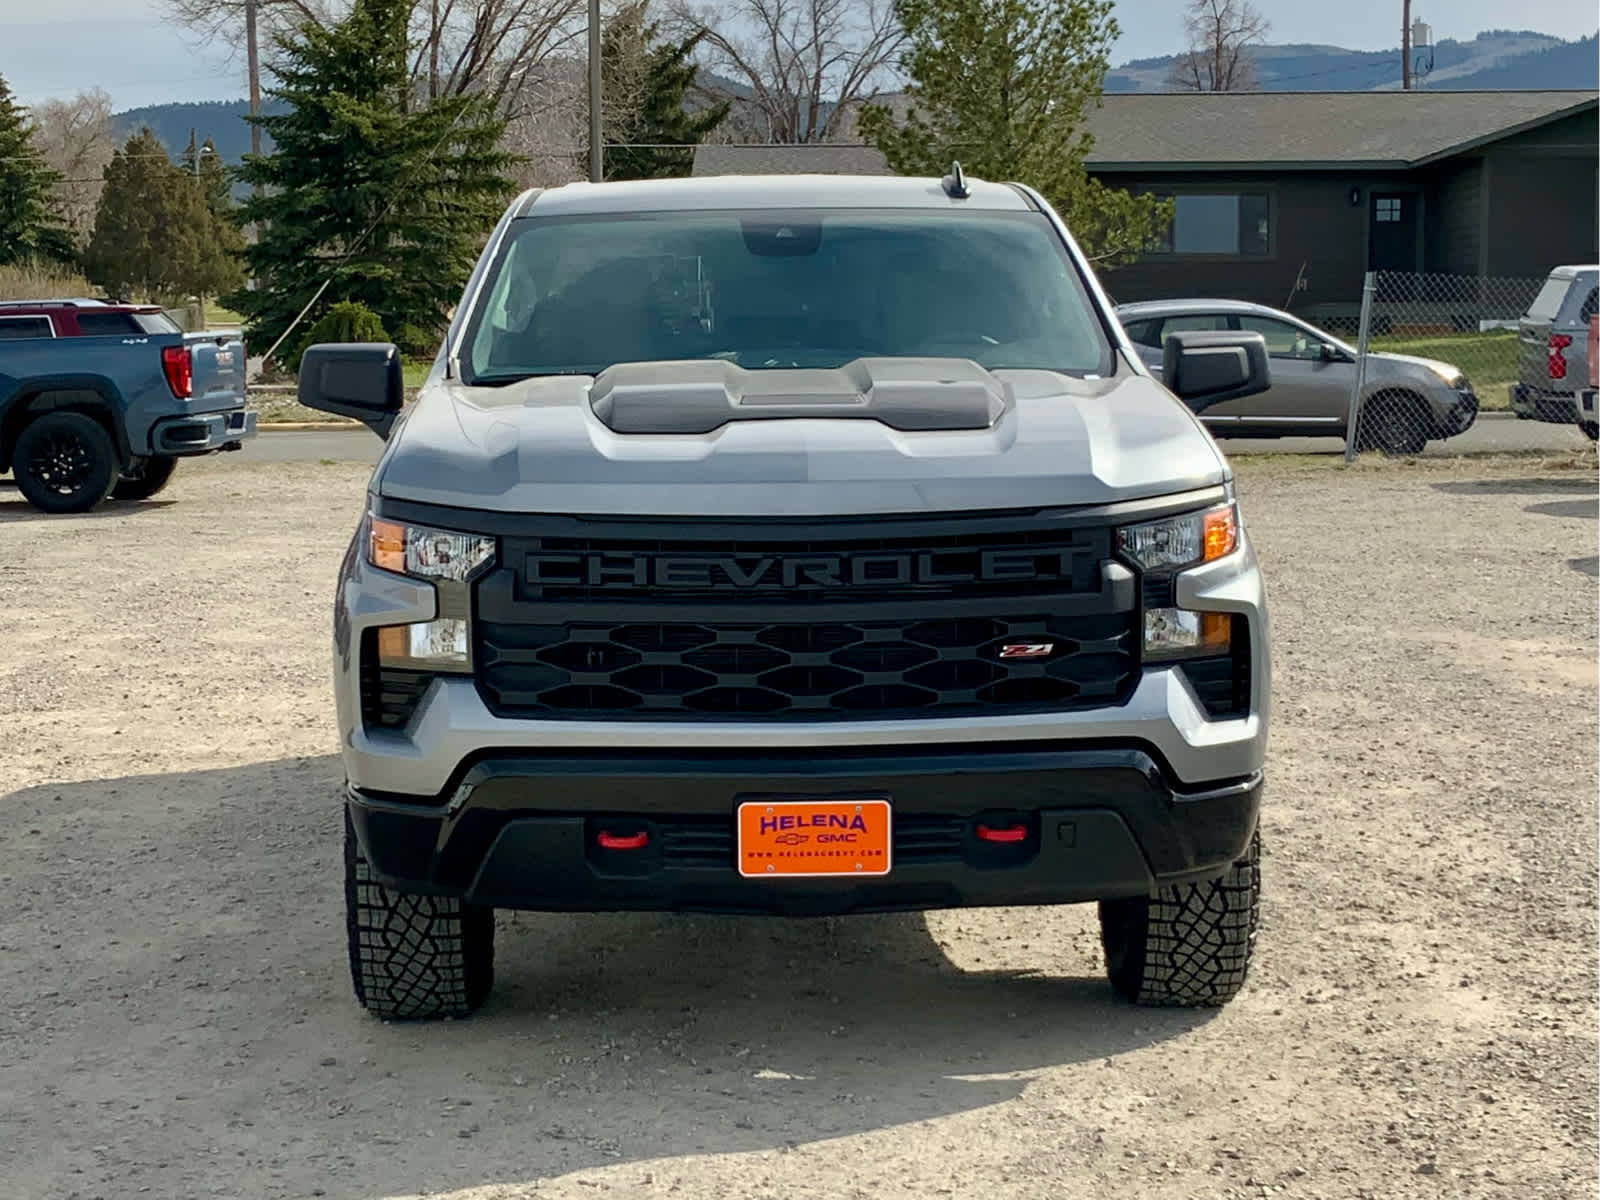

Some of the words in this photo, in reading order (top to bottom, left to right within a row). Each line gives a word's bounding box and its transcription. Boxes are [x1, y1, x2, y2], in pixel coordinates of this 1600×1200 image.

[524, 546, 1095, 587] CHEVROLET
[760, 814, 867, 835] HELENA
[817, 833, 857, 843] GMC
